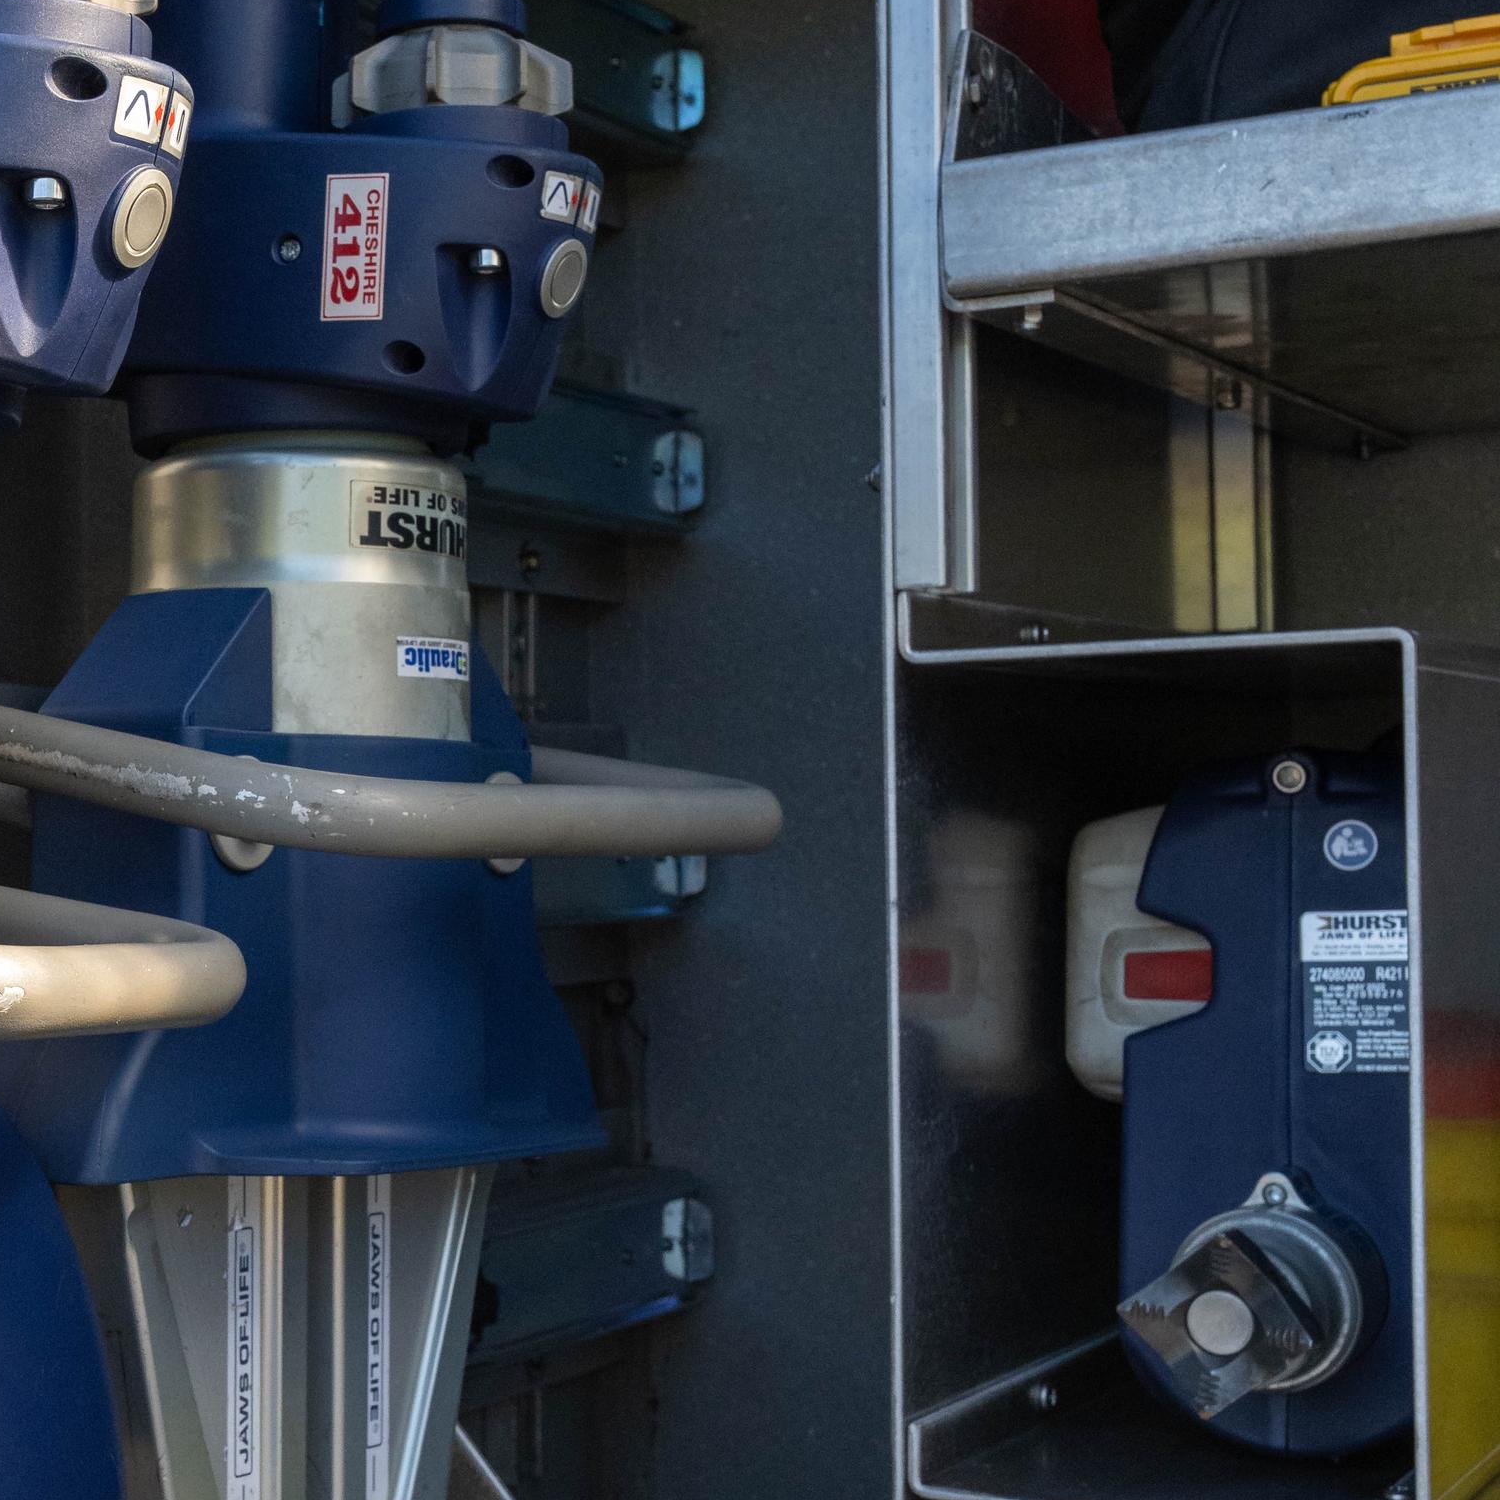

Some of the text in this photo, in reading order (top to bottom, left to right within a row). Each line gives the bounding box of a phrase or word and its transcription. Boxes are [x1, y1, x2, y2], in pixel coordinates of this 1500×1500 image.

[330, 193, 362, 305] 412
[362, 189, 381, 305] CHESHIRE
[426, 493, 447, 512] OF
[359, 510, 466, 561] HURST
[1318, 931, 1353, 941] JAWS
[1359, 931, 1375, 940] OF
[369, 1224, 381, 1311] JAWS
[238, 1326, 250, 1366] OF
[369, 1316, 380, 1356] OF
[238, 1372, 250, 1464] JAWS
